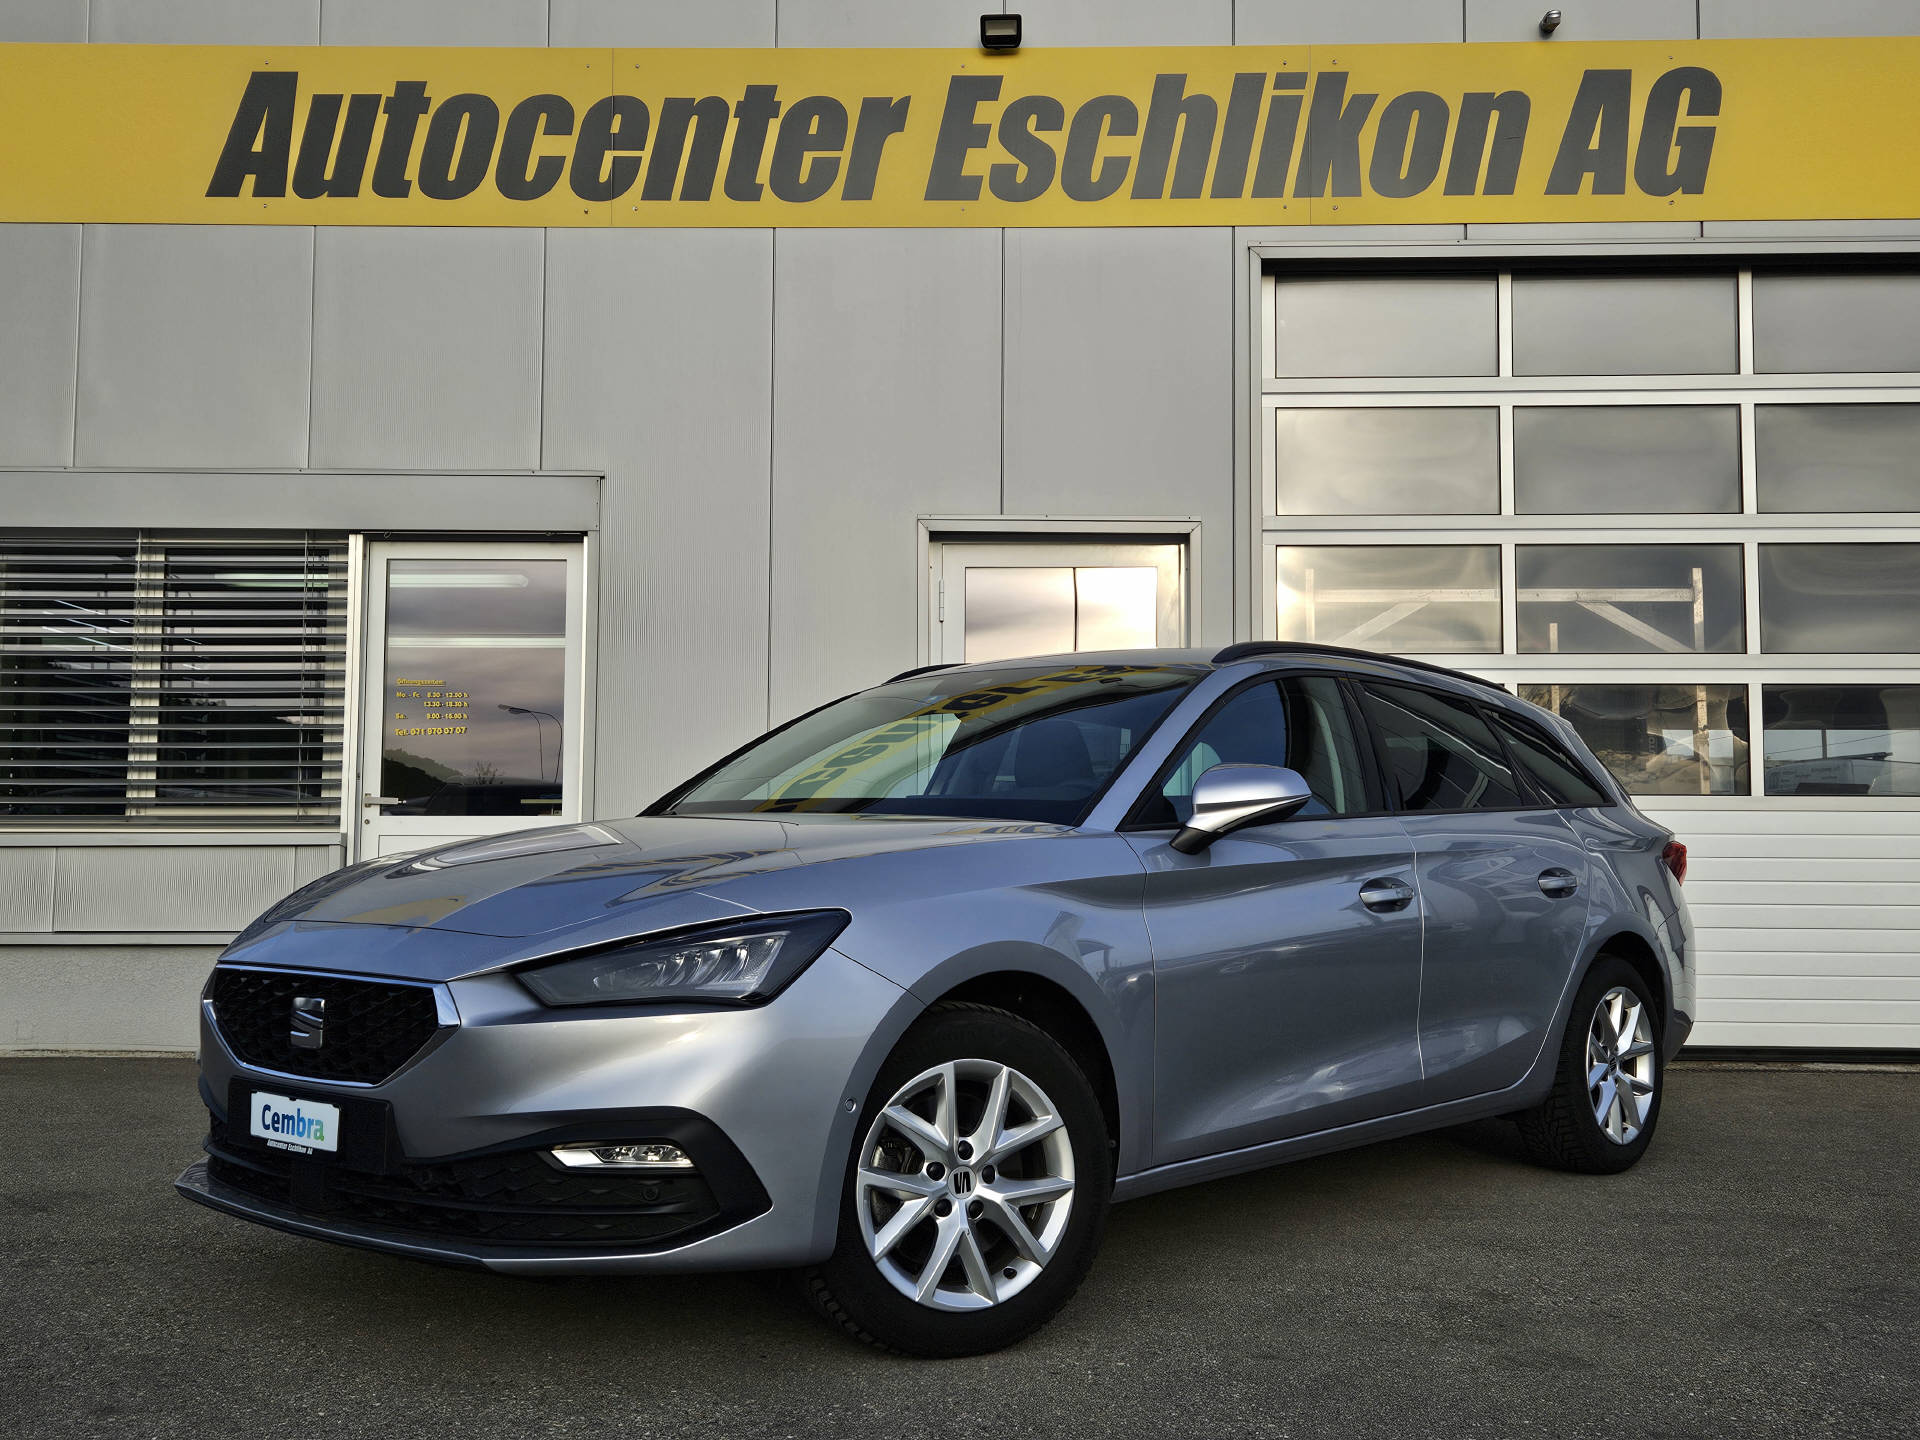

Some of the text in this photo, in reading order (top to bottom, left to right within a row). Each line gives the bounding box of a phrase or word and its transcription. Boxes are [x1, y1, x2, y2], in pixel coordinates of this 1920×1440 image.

[205, 66, 1723, 203] Autocenter Eschlikon AG
[262, 1104, 324, 1141] Cembra
